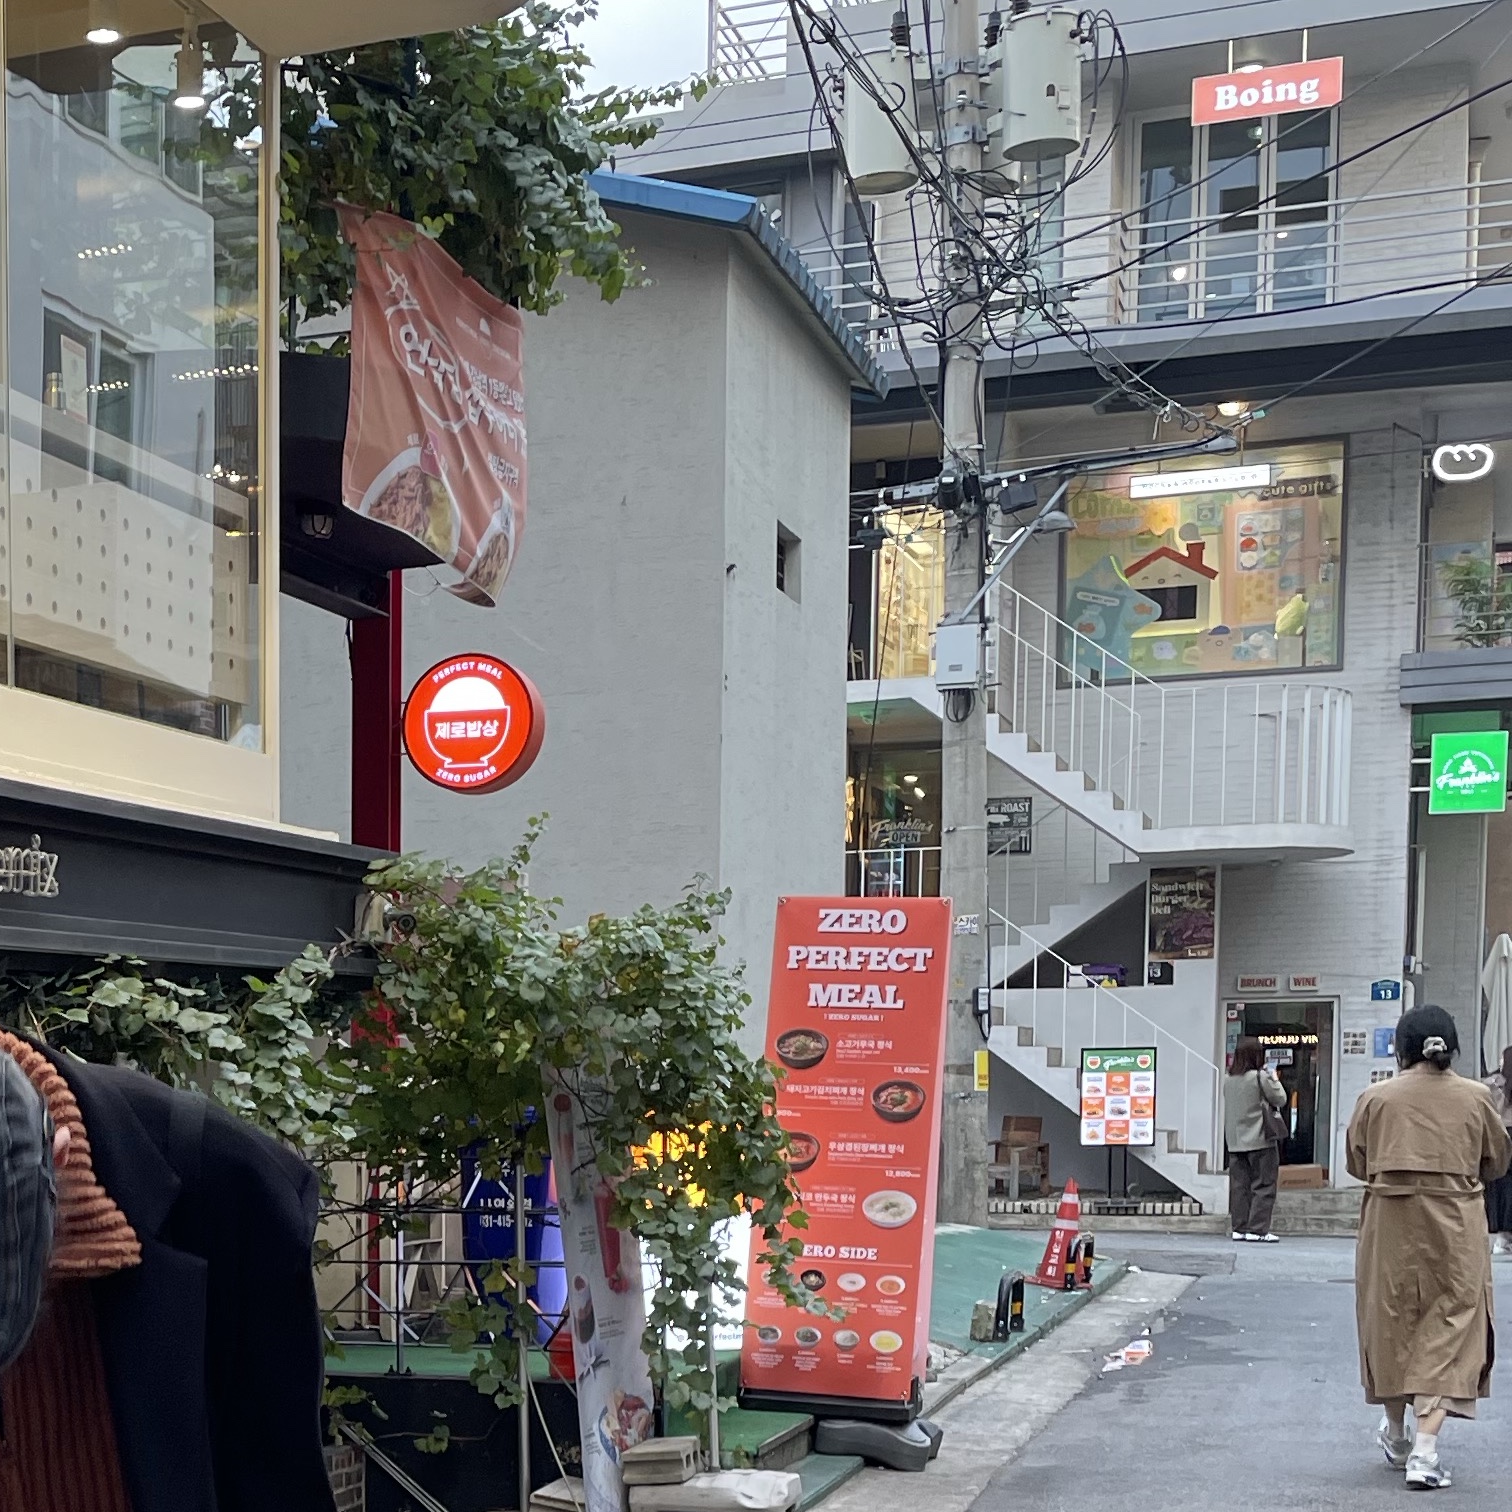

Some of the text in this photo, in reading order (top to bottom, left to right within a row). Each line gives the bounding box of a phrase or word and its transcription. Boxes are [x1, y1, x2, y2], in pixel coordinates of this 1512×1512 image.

[1214, 78, 1320, 111] Boing
[432, 662, 503, 683] PERFECT MEAL
[435, 720, 499, 739] 제로밥상
[435, 766, 497, 783] ZERO SUGAR
[1000, 802, 1030, 813] ROAST
[891, 831, 919, 842] OPEN
[817, 908, 908, 935] ZERO
[786, 945, 934, 973] PERFECT
[1240, 976, 1277, 988] BRUNCH
[1293, 976, 1317, 987] WINE
[807, 983, 905, 1010] MEAL
[1380, 989, 1393, 1000] 13
[828, 1013, 880, 1021] ZERO SUGAR
[802, 1243, 879, 1260] ERO SIDE
